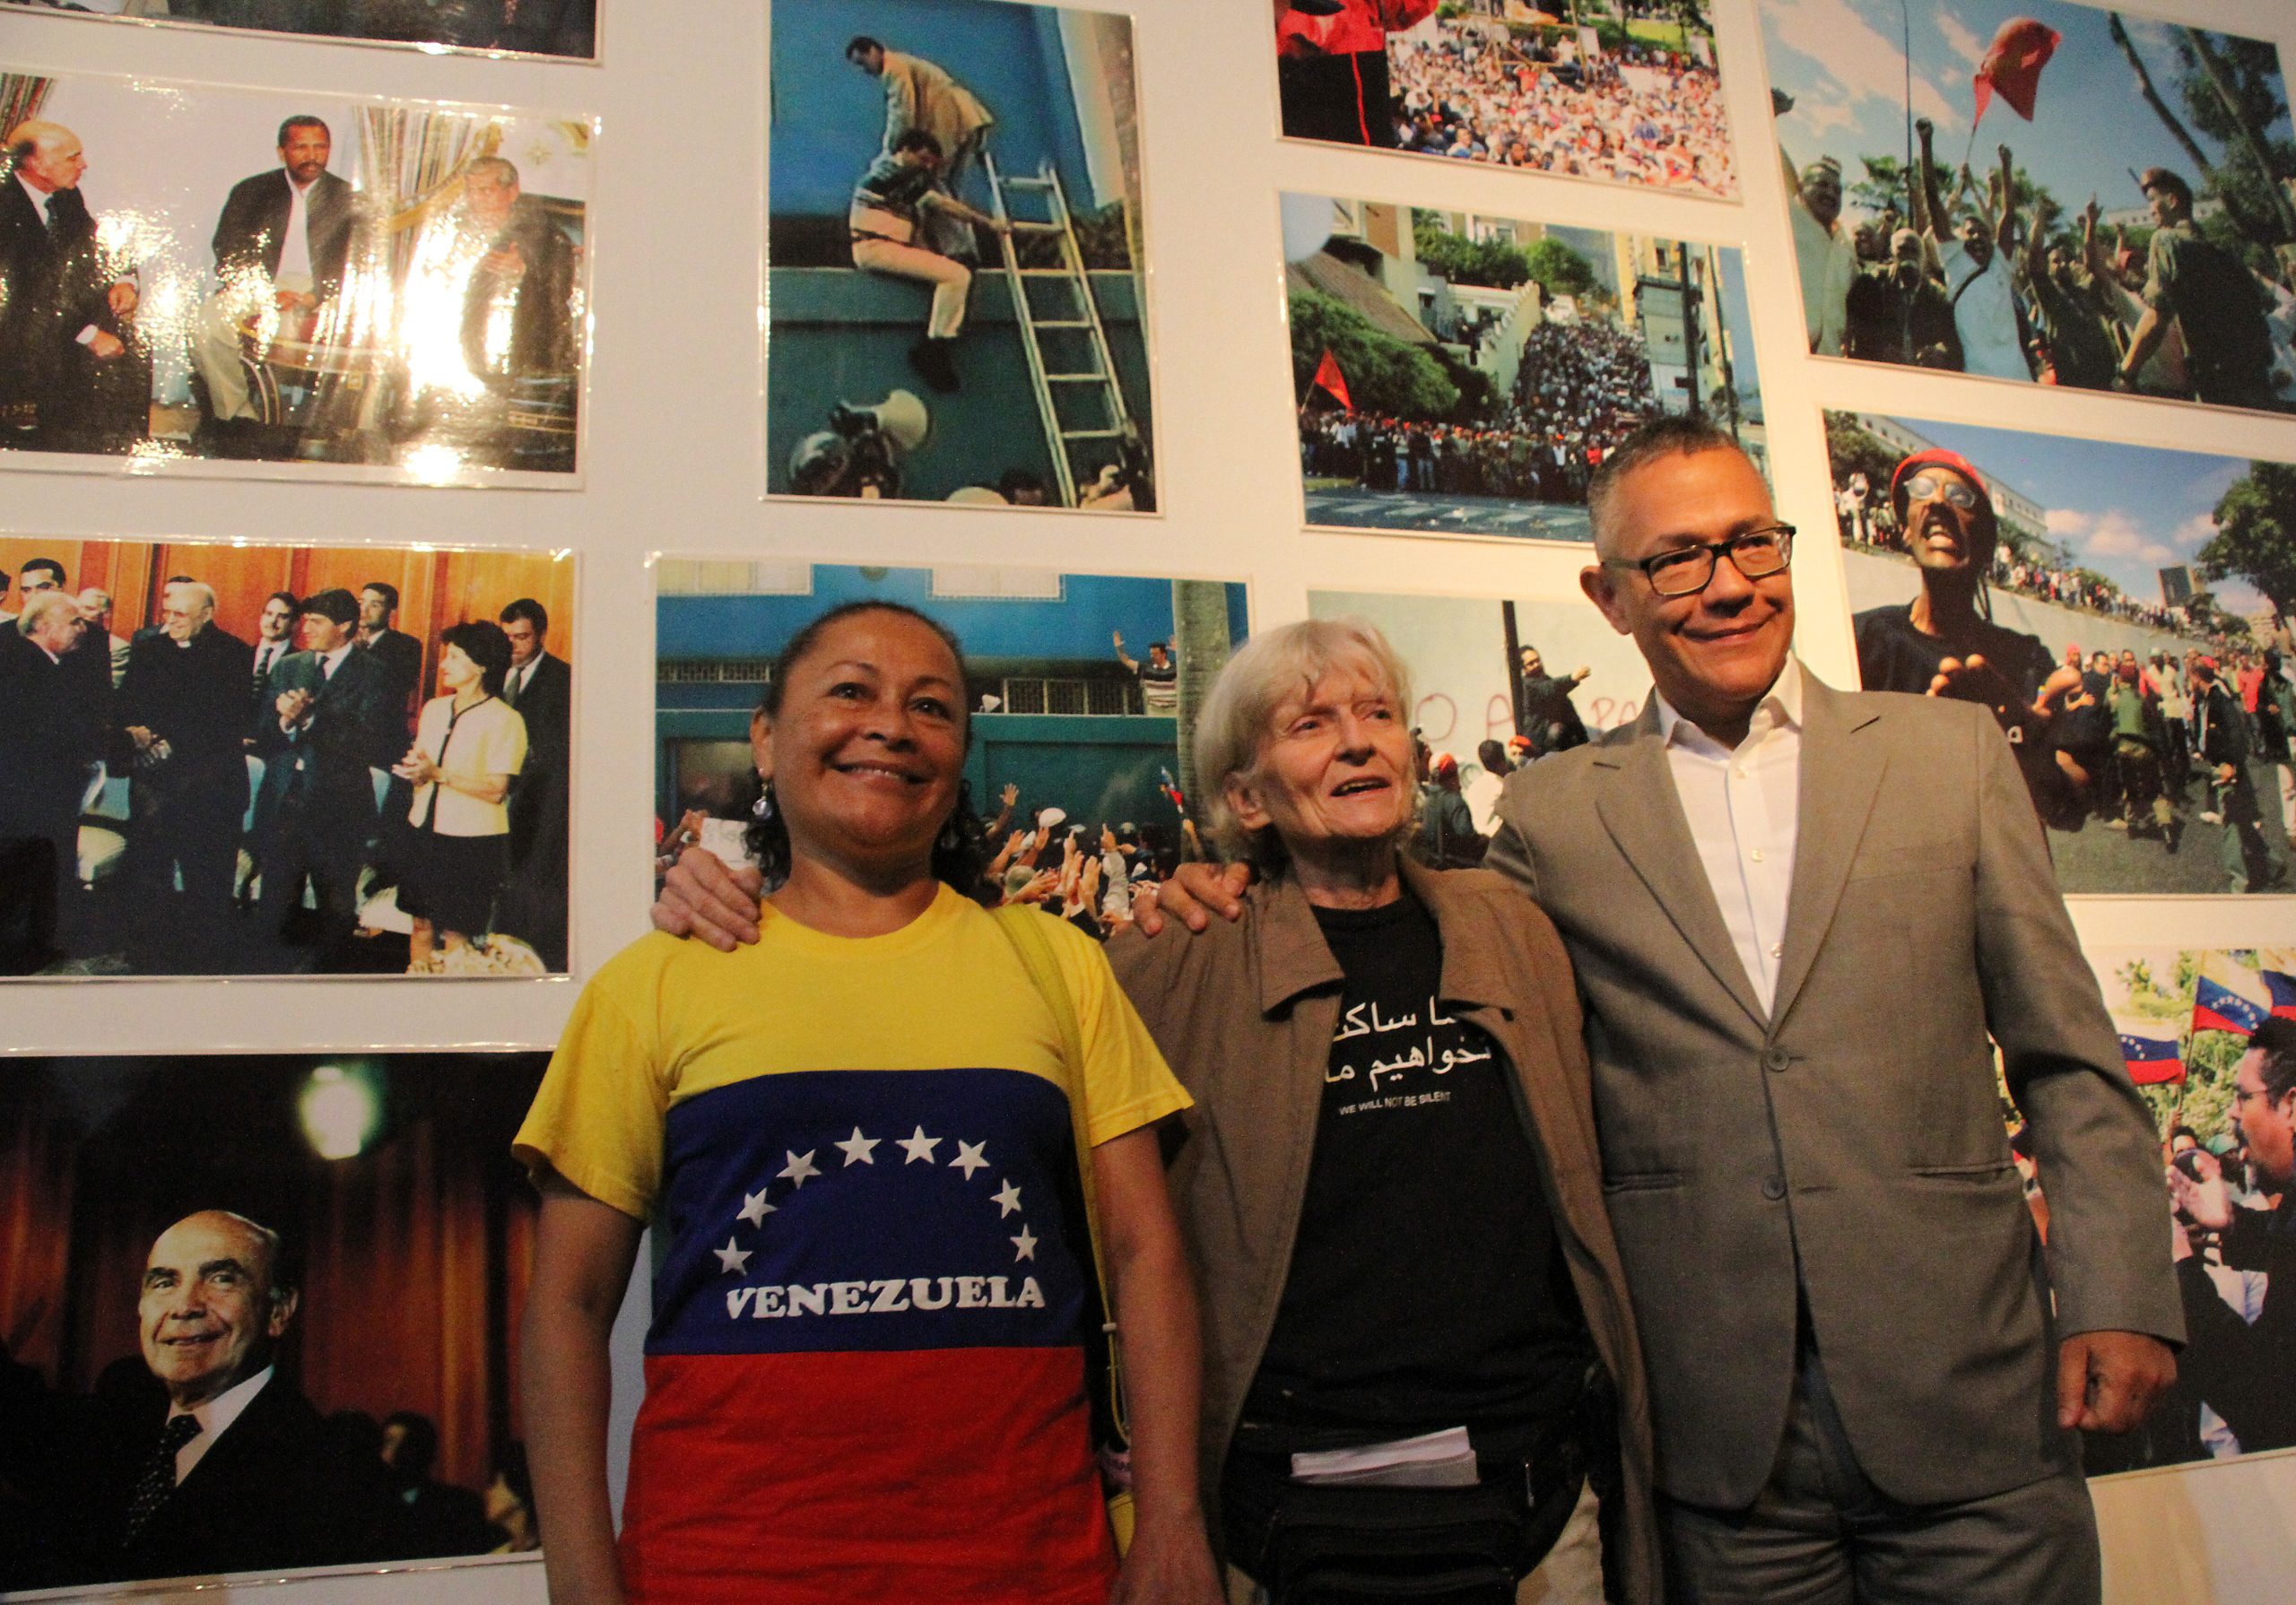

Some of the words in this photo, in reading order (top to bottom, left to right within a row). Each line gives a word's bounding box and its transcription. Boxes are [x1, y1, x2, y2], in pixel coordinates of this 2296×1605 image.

[1339, 1105, 1356, 1115] WE
[1358, 1099, 1383, 1112] WILL
[1384, 1097, 1403, 1108] NOT
[1404, 1096, 1418, 1107] BE
[1419, 1091, 1451, 1105] SILENT
[726, 1276, 1045, 1319] VENEZUELA
